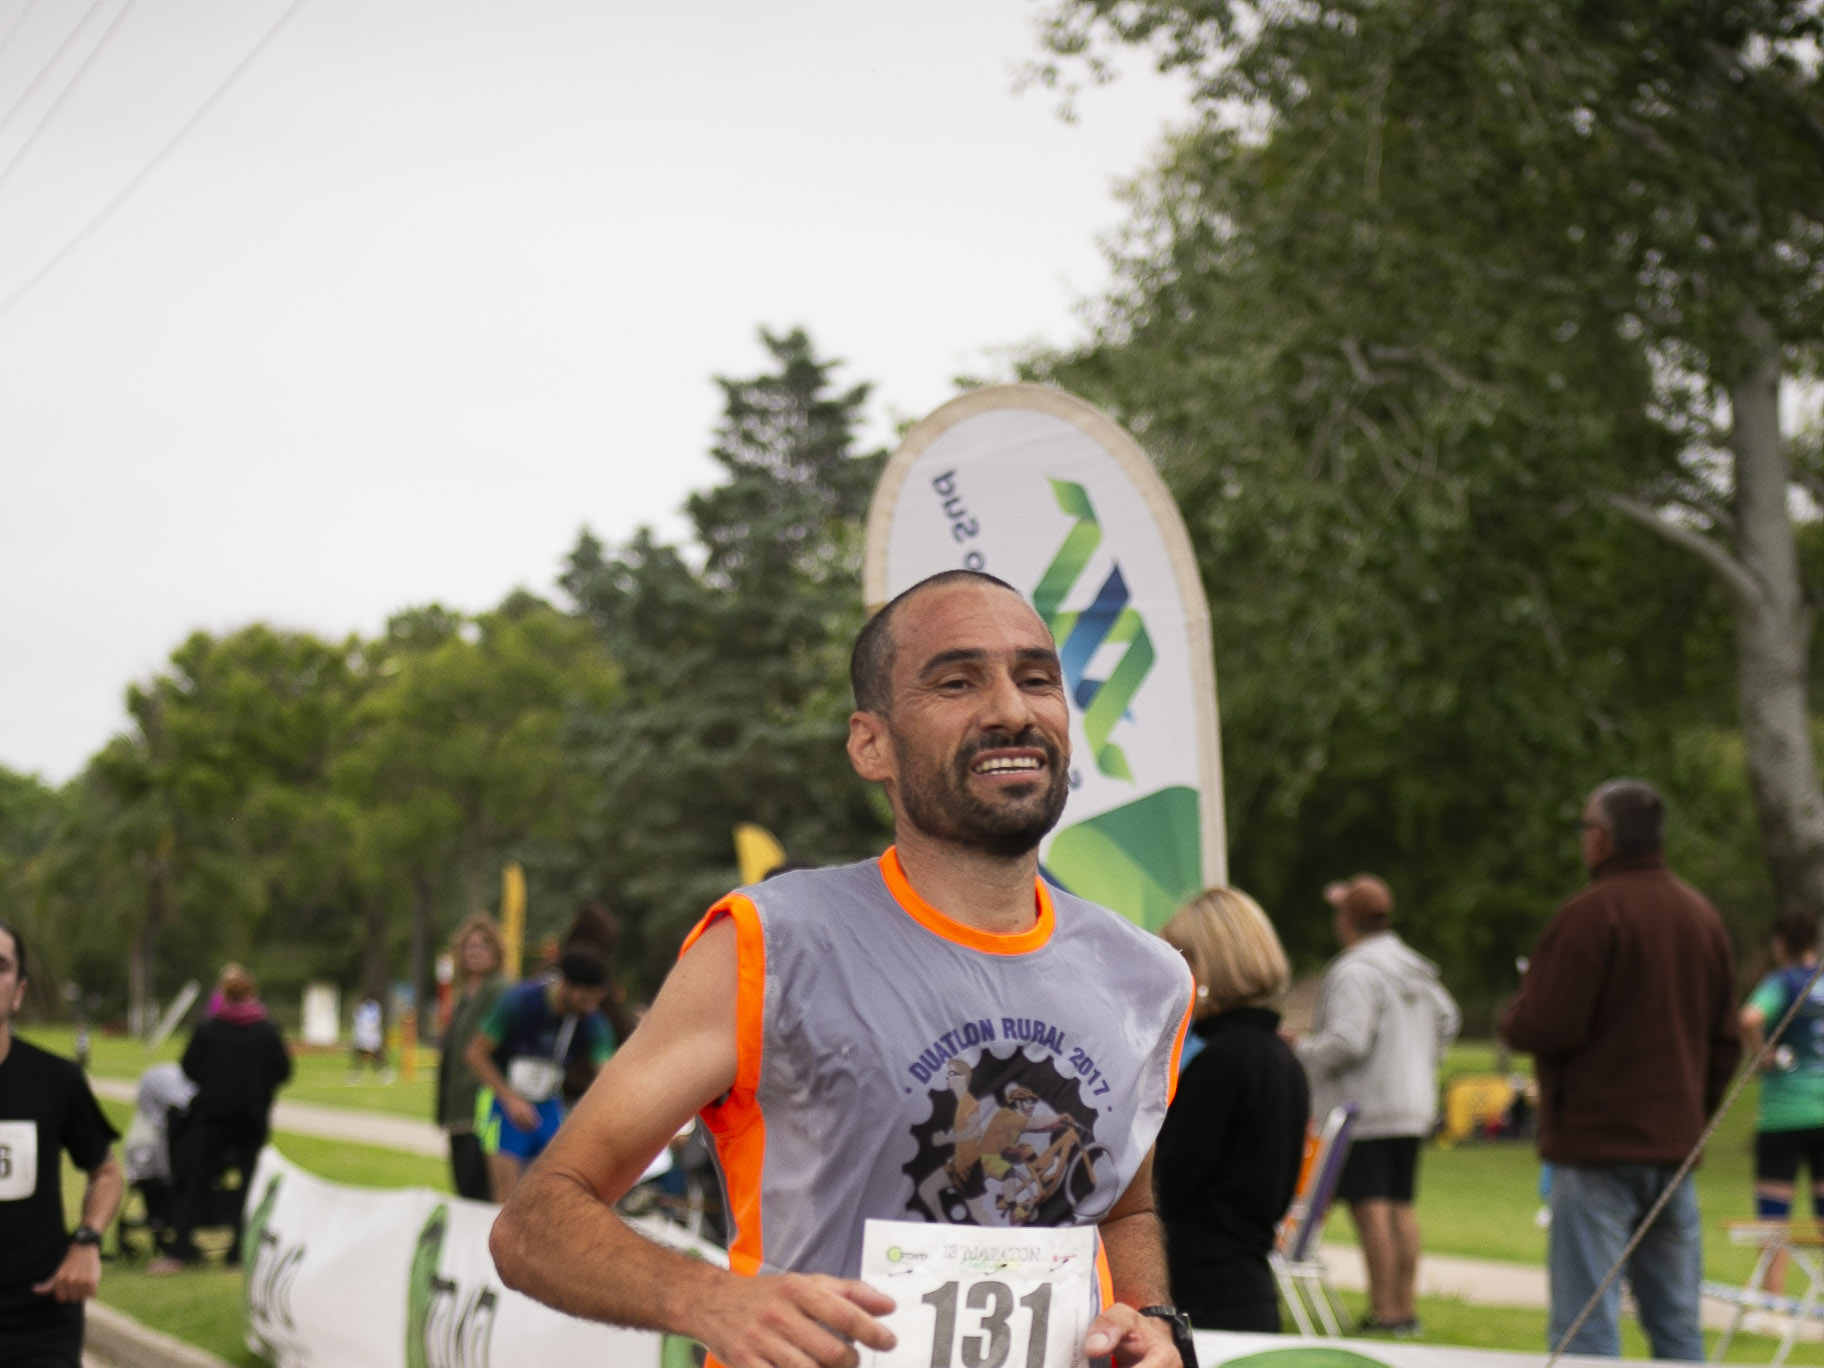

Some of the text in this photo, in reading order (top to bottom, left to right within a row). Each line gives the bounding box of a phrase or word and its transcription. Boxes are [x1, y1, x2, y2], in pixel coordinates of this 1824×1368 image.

[908, 1017, 1111, 1097] DUATLON RURAL 2017
